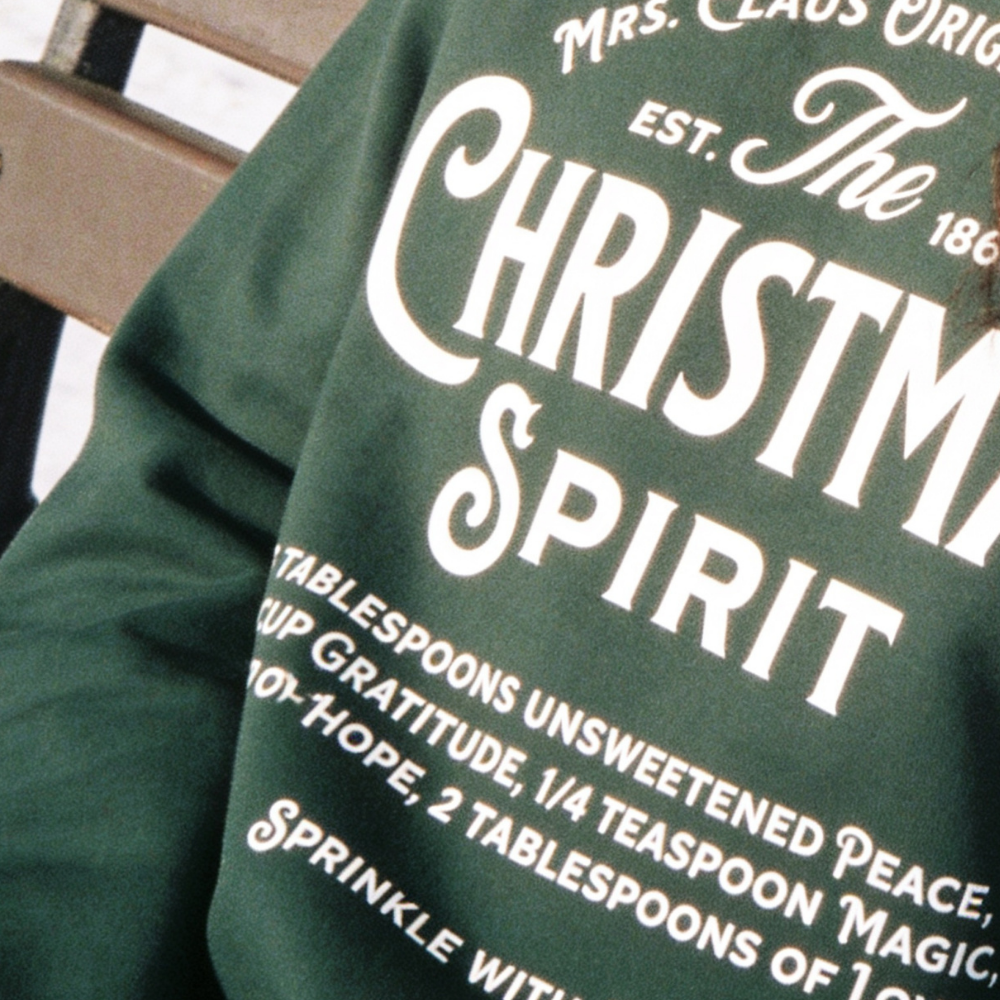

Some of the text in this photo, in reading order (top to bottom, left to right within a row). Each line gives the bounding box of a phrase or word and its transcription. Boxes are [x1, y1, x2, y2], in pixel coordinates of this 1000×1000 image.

[627, 99, 723, 162] EST.
[729, 65, 969, 222] The
[427, 382, 905, 717] SPIRIT
[277, 547, 992, 928] TABLESPOONS UNSWEETENED PEACE,
[311, 631, 528, 799] GRATITUDE,
[533, 767, 595, 823] 1/4
[596, 794, 824, 927] TEASPOON
[837, 894, 998, 987] MAGIC,
[246, 801, 582, 1000] SPRINKLE WIT
[426, 788, 464, 824] 2
[465, 800, 763, 969] TABLESPOONS
[769, 946, 840, 995] OF
